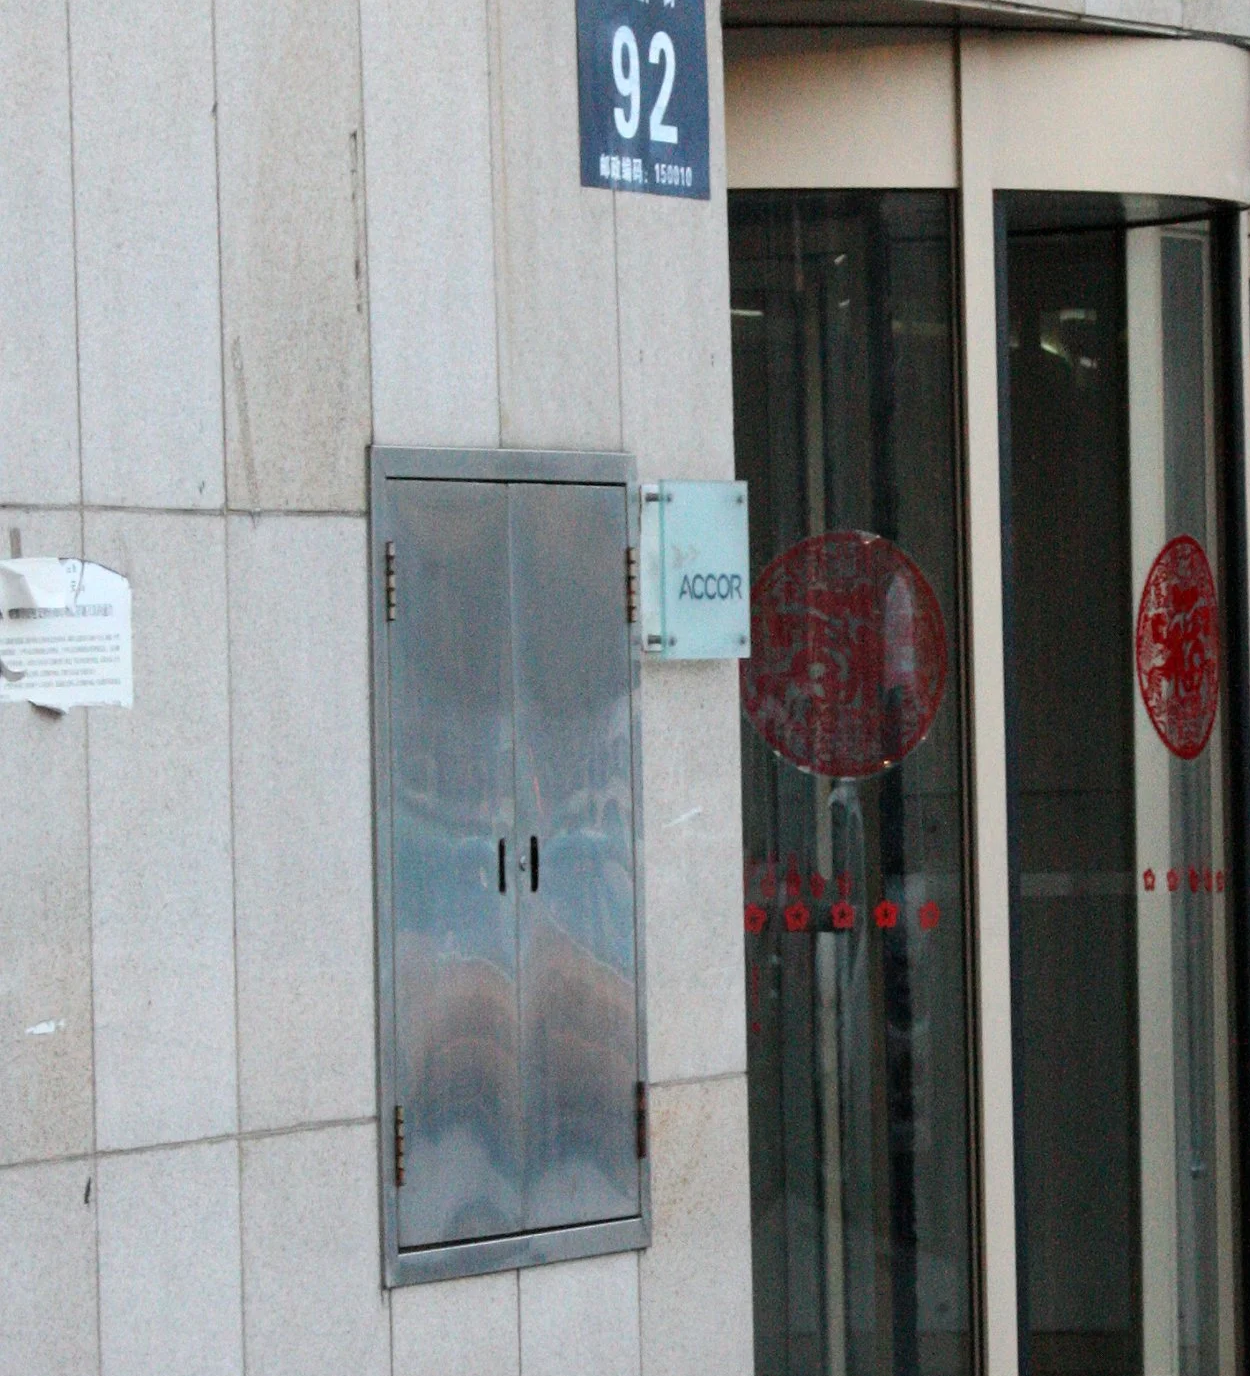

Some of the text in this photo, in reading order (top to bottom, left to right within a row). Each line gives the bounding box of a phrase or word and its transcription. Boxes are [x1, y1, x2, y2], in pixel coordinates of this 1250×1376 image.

[611, 25, 678, 144] 92
[654, 163, 693, 187] 150010
[679, 574, 742, 600] ACCOR
